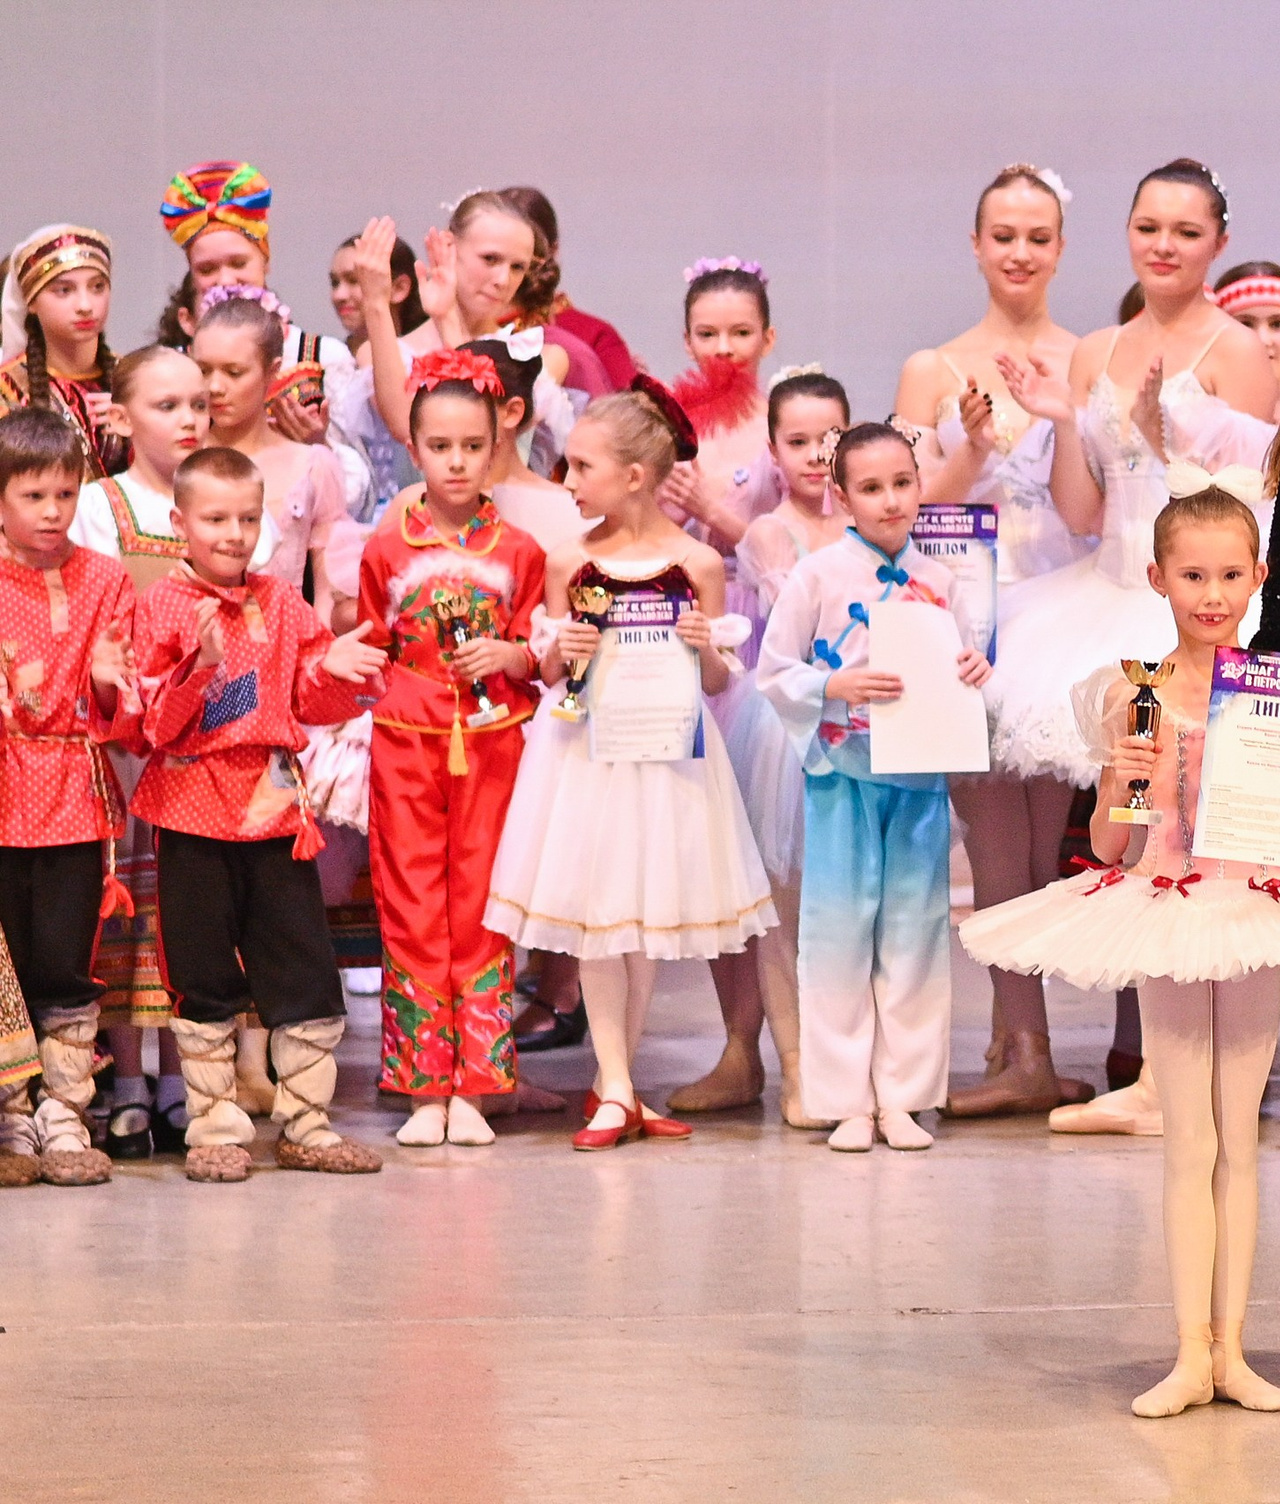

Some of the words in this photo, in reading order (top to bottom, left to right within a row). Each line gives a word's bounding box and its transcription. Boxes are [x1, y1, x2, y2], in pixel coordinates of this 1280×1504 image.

[615, 630, 670, 645] ДИПЛОМ
[1246, 663, 1274, 676] ШАГ
[1245, 675, 1252, 686] В
